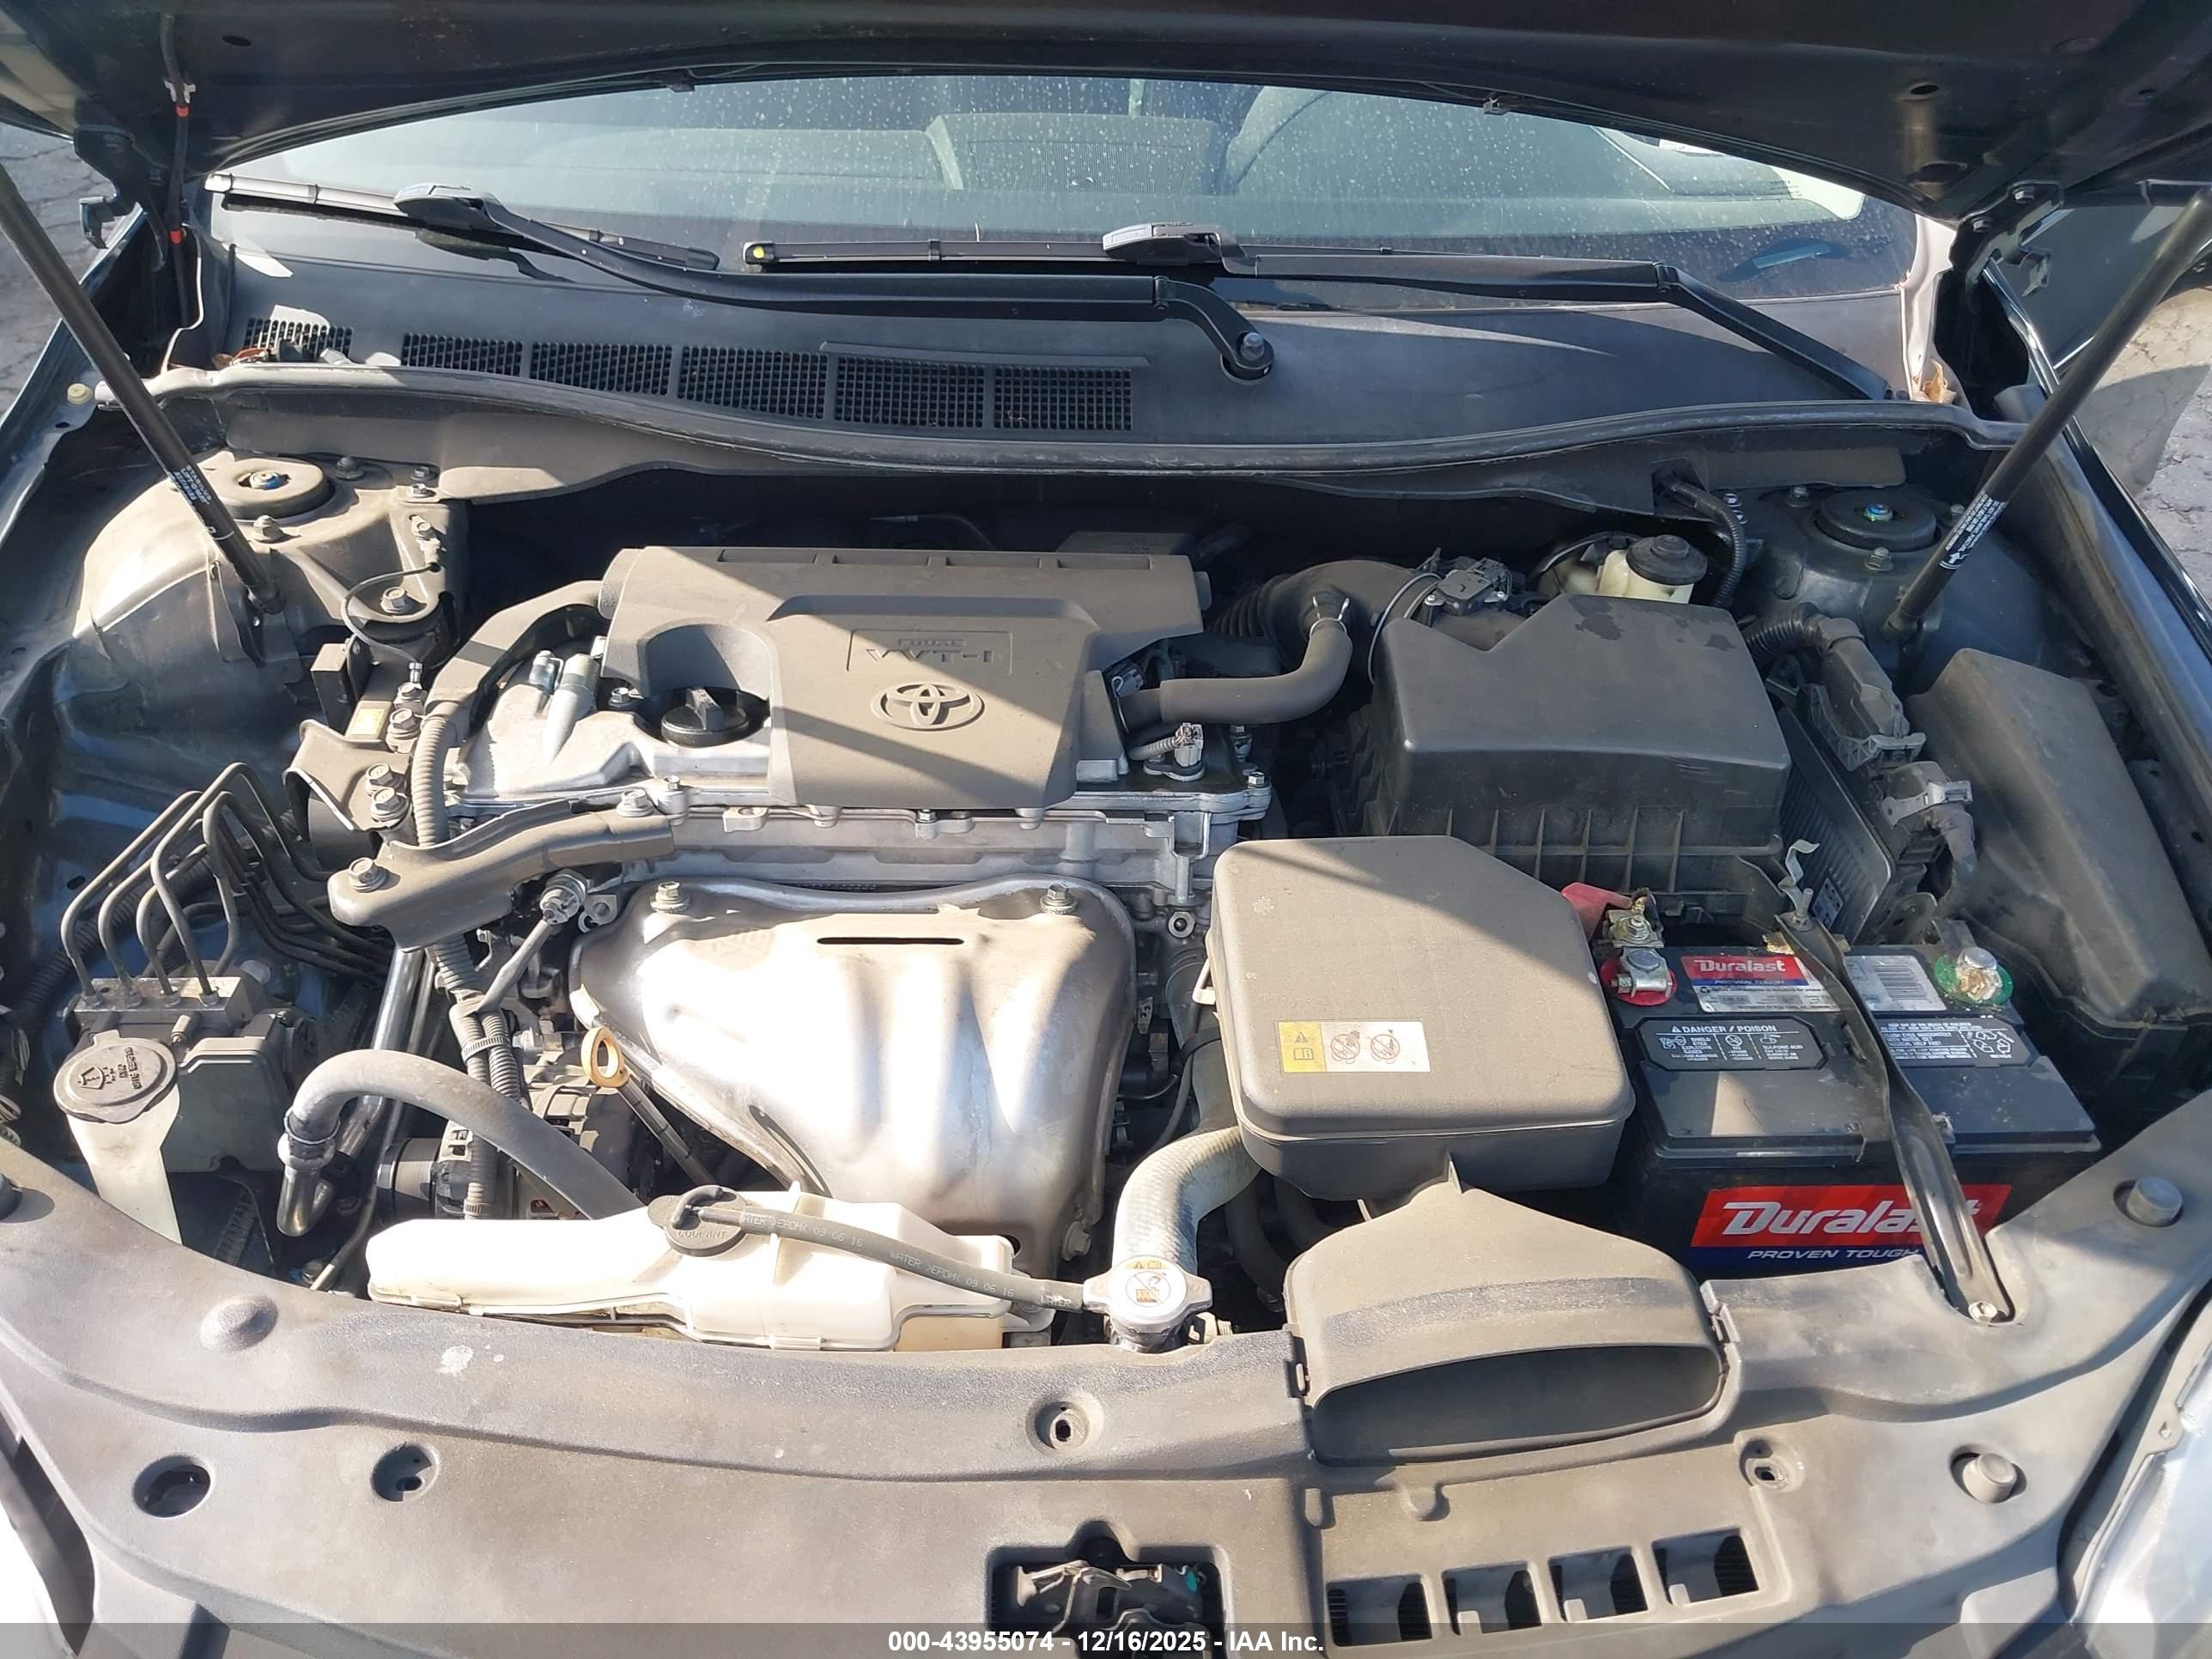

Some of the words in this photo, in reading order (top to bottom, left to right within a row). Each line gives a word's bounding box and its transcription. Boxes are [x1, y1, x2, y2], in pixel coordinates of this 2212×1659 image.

[1693, 959, 1786, 972] Duralast
[740, 1213, 765, 1226] ATER
[831, 1231, 846, 1242] 06
[1723, 1200, 1979, 1235] Durala
[1747, 1250, 1838, 1259] PROVEN
[965, 1277, 979, 1287] 09
[983, 1282, 996, 1293] 06
[1002, 1287, 1014, 1297] 16
